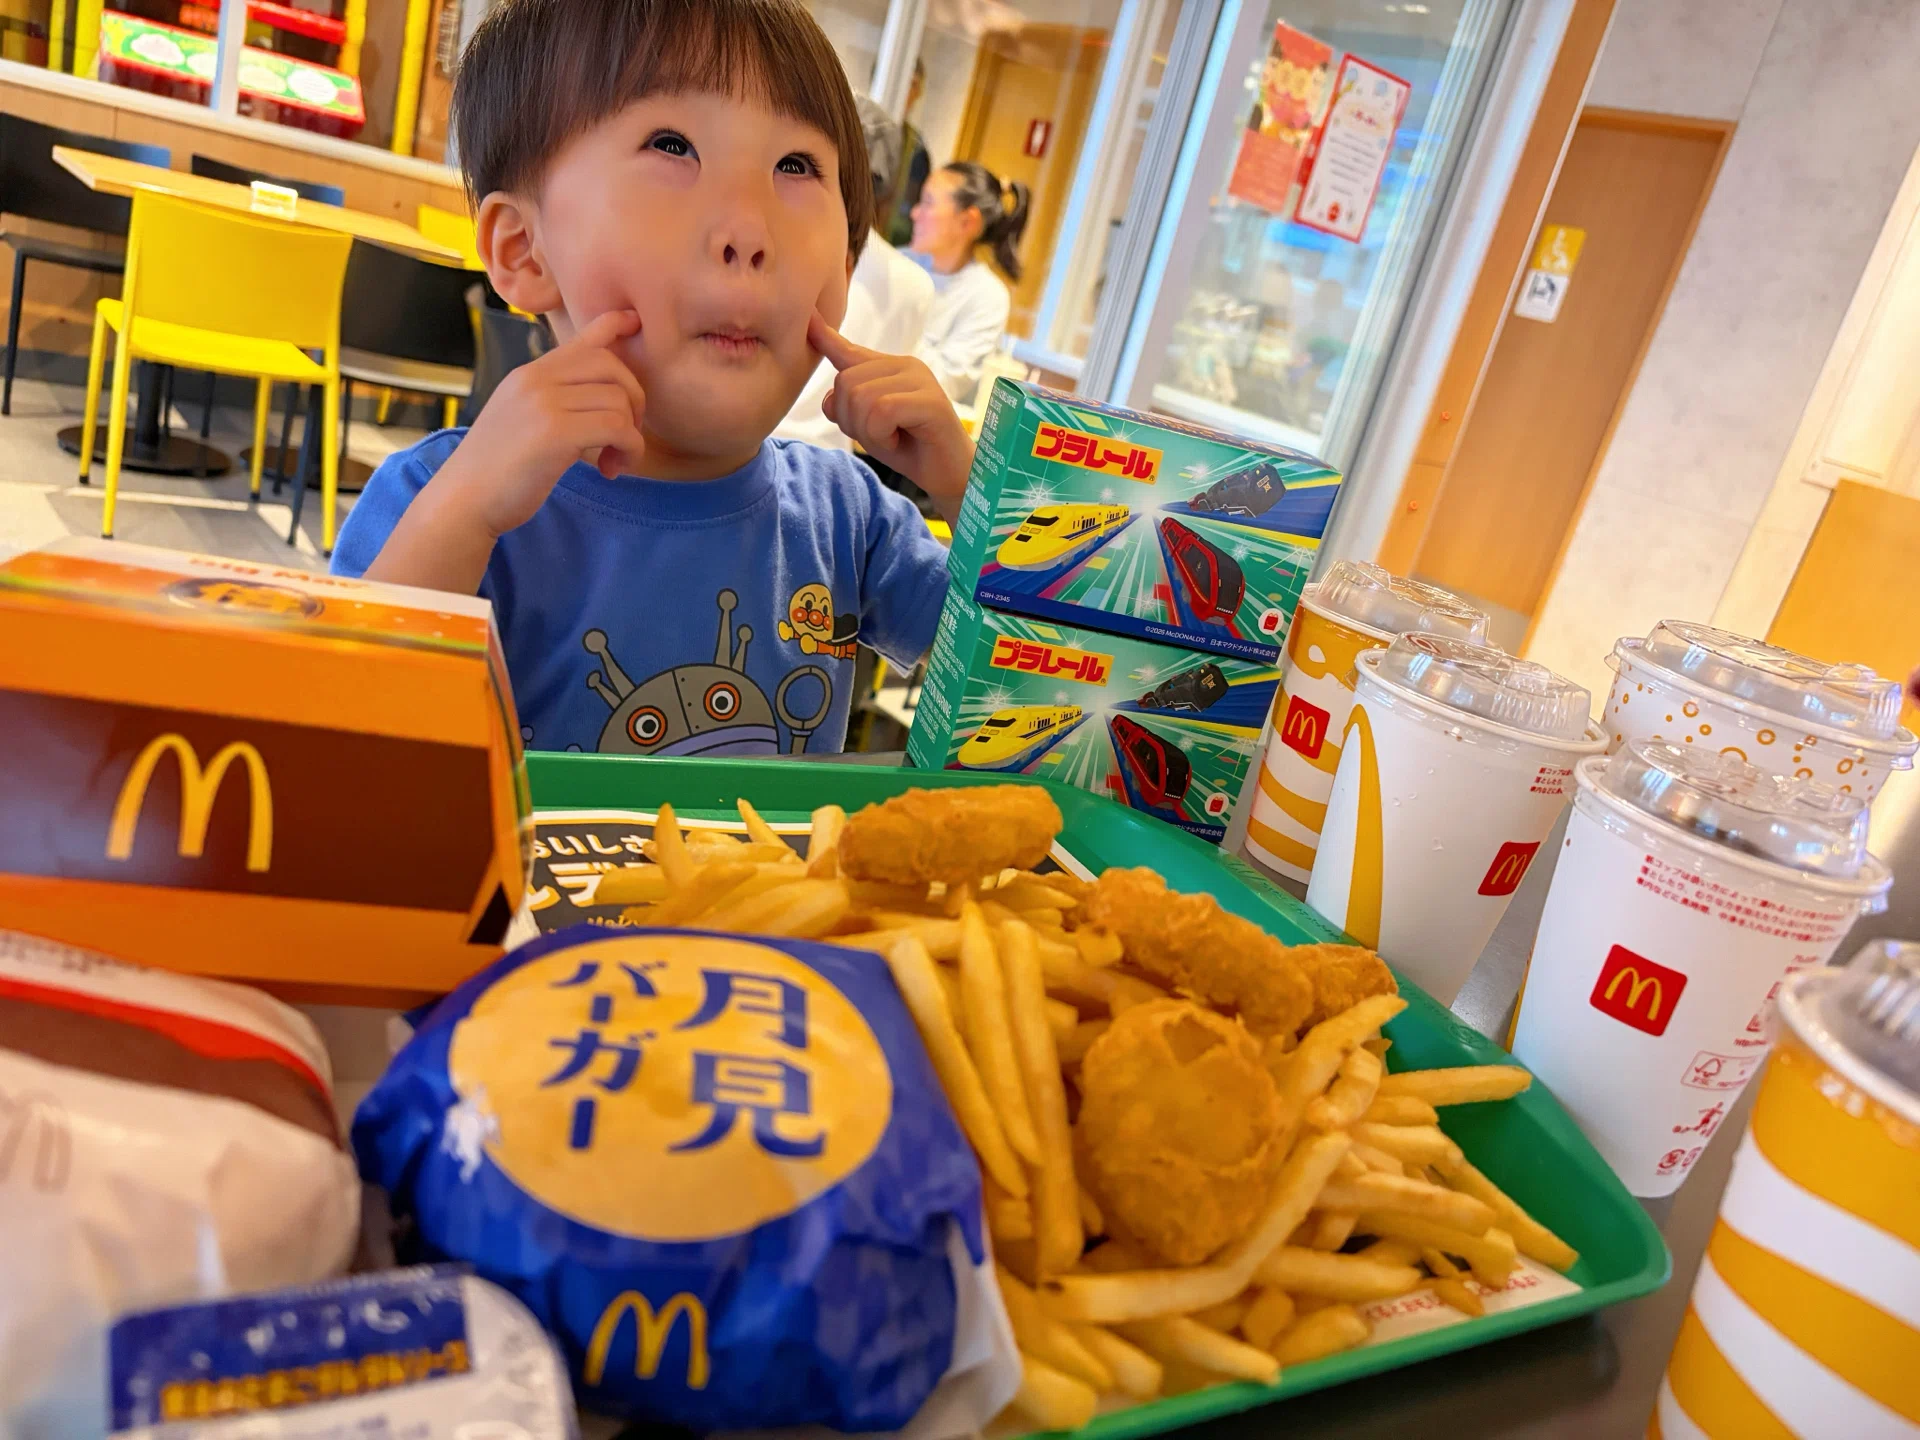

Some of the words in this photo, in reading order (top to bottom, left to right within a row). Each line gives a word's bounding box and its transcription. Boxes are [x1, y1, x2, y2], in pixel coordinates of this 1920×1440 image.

[1035, 427, 1154, 481] プラレール
[980, 591, 1011, 603] CBH-2345
[993, 640, 1105, 682] プラレール
[1166, 630, 1206, 644] McDONALD'S
[1209, 638, 1277, 658] 日本マクドナルド株式会社
[539, 960, 668, 1153] バーガー
[667, 967, 827, 1162] 月見
